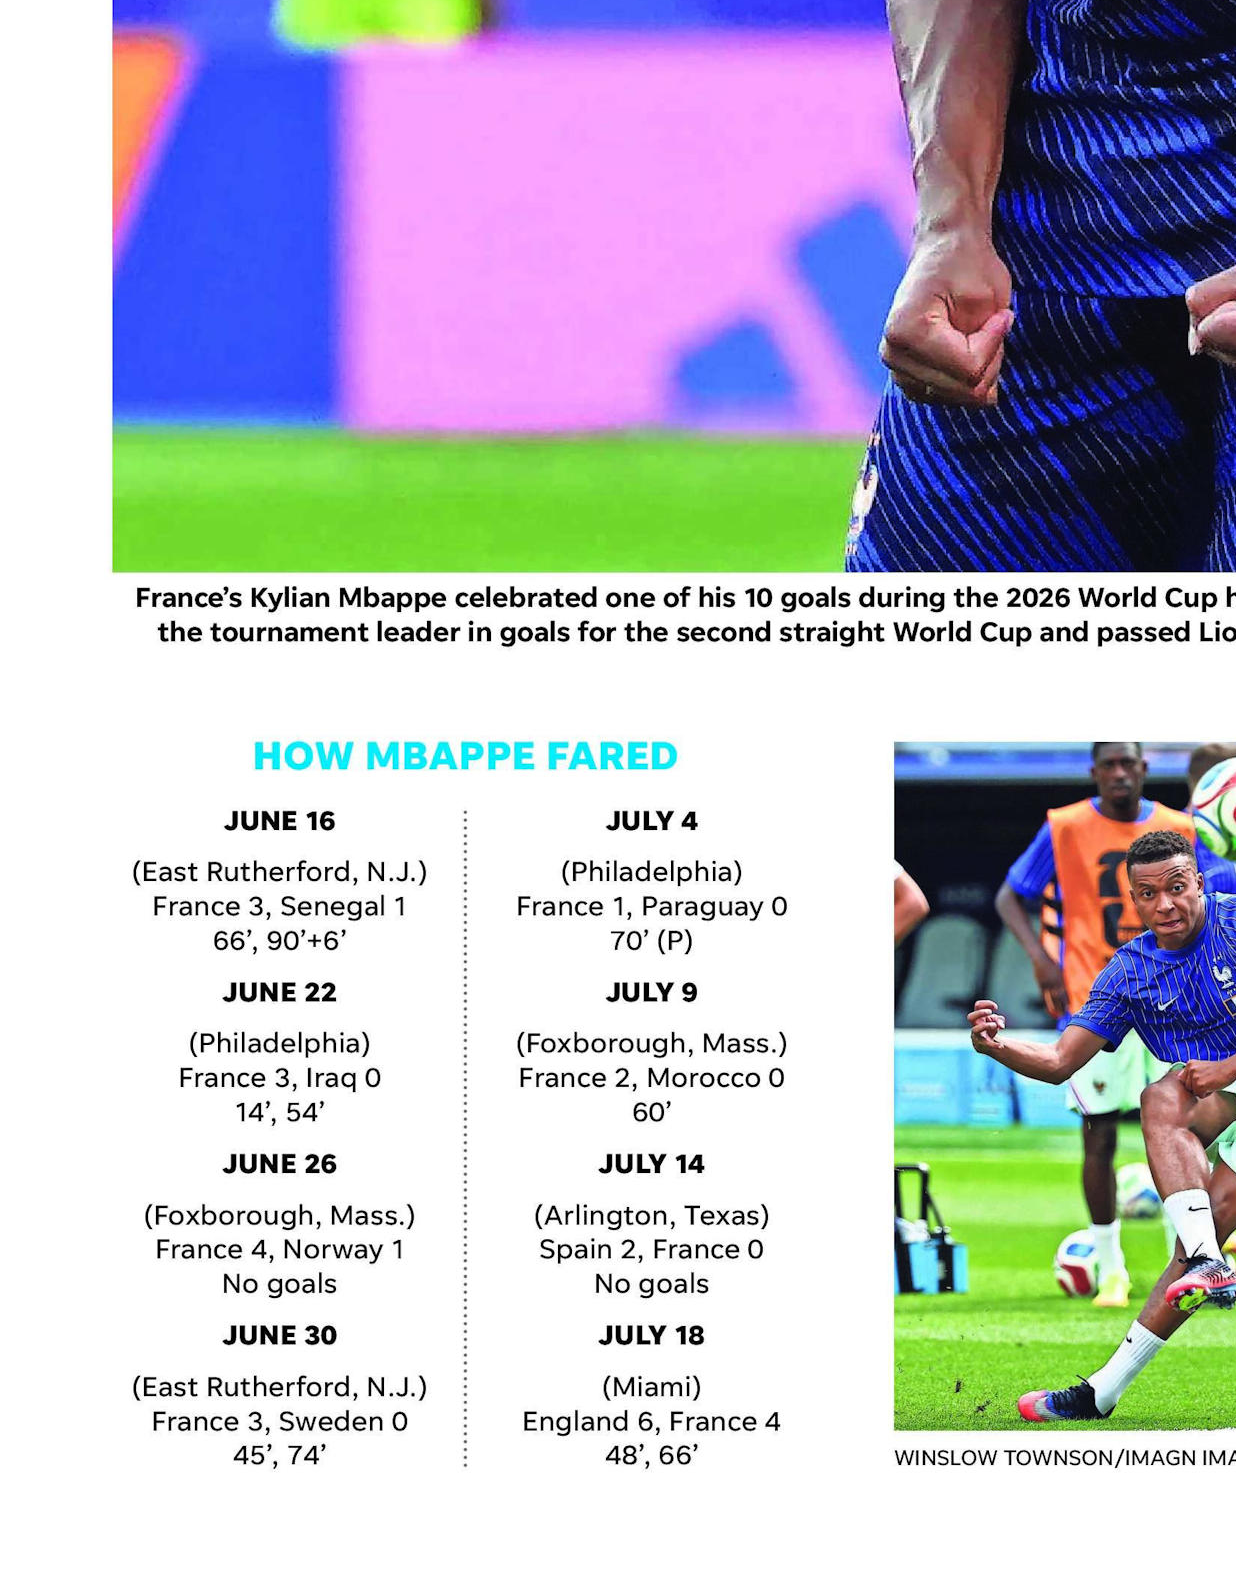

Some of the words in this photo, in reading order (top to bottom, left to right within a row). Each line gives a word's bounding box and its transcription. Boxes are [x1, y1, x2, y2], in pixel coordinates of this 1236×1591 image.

[137, 587, 242, 607] France’s
[252, 586, 329, 612] Kylian
[340, 586, 446, 612] Mbappe
[456, 586, 597, 607] celebrated
[606, 592, 655, 607] one
[664, 586, 691, 607] of
[700, 586, 735, 607] his
[745, 588, 772, 607] 10
[781, 586, 850, 612] goals
[859, 586, 944, 612] during
[954, 586, 998, 607] the
[1007, 588, 1070, 608] 2026
[1078, 586, 1156, 607] World
[1165, 588, 1217, 612] Cup
[158, 621, 202, 642] the
[210, 623, 369, 642] tournament
[378, 621, 460, 642] leader
[469, 621, 491, 641] in
[500, 621, 570, 647] goals
[578, 621, 616, 642] for
[624, 621, 668, 642] the
[677, 621, 770, 642] second
[780, 621, 884, 647] straight
[894, 621, 971, 642] World
[980, 622, 1032, 647] Cup
[1040, 621, 1088, 642] and
[1098, 621, 1190, 647] passed
[255, 741, 353, 770] HOW
[367, 742, 534, 769] MBAPPE
[549, 742, 677, 770] FARED
[224, 811, 296, 831] JUNE
[307, 811, 335, 831] 16
[133, 860, 198, 886] (East
[208, 860, 357, 885] Rutherford,
[369, 860, 426, 886] N.J.)
[154, 896, 240, 916] France
[250, 897, 270, 920] 3,
[282, 895, 384, 921] Senegal
[396, 897, 403, 915] 1
[214, 929, 257, 954] 66’,
[268, 929, 346, 950] 90’+6’
[599, 1325, 666, 1345] JULY
[676, 1325, 704, 1345] 18
[604, 1376, 700, 1401] (Miami)
[524, 1410, 627, 1436] England
[639, 1412, 660, 1435] 6,
[671, 1412, 757, 1431] France
[765, 1412, 780, 1431] 4
[606, 1444, 649, 1469] 48’,
[660, 1444, 697, 1465] 66’
[895, 1450, 997, 1465] WINSLOW
[1004, 1449, 1195, 1468] TOWNSON/IMAGN
